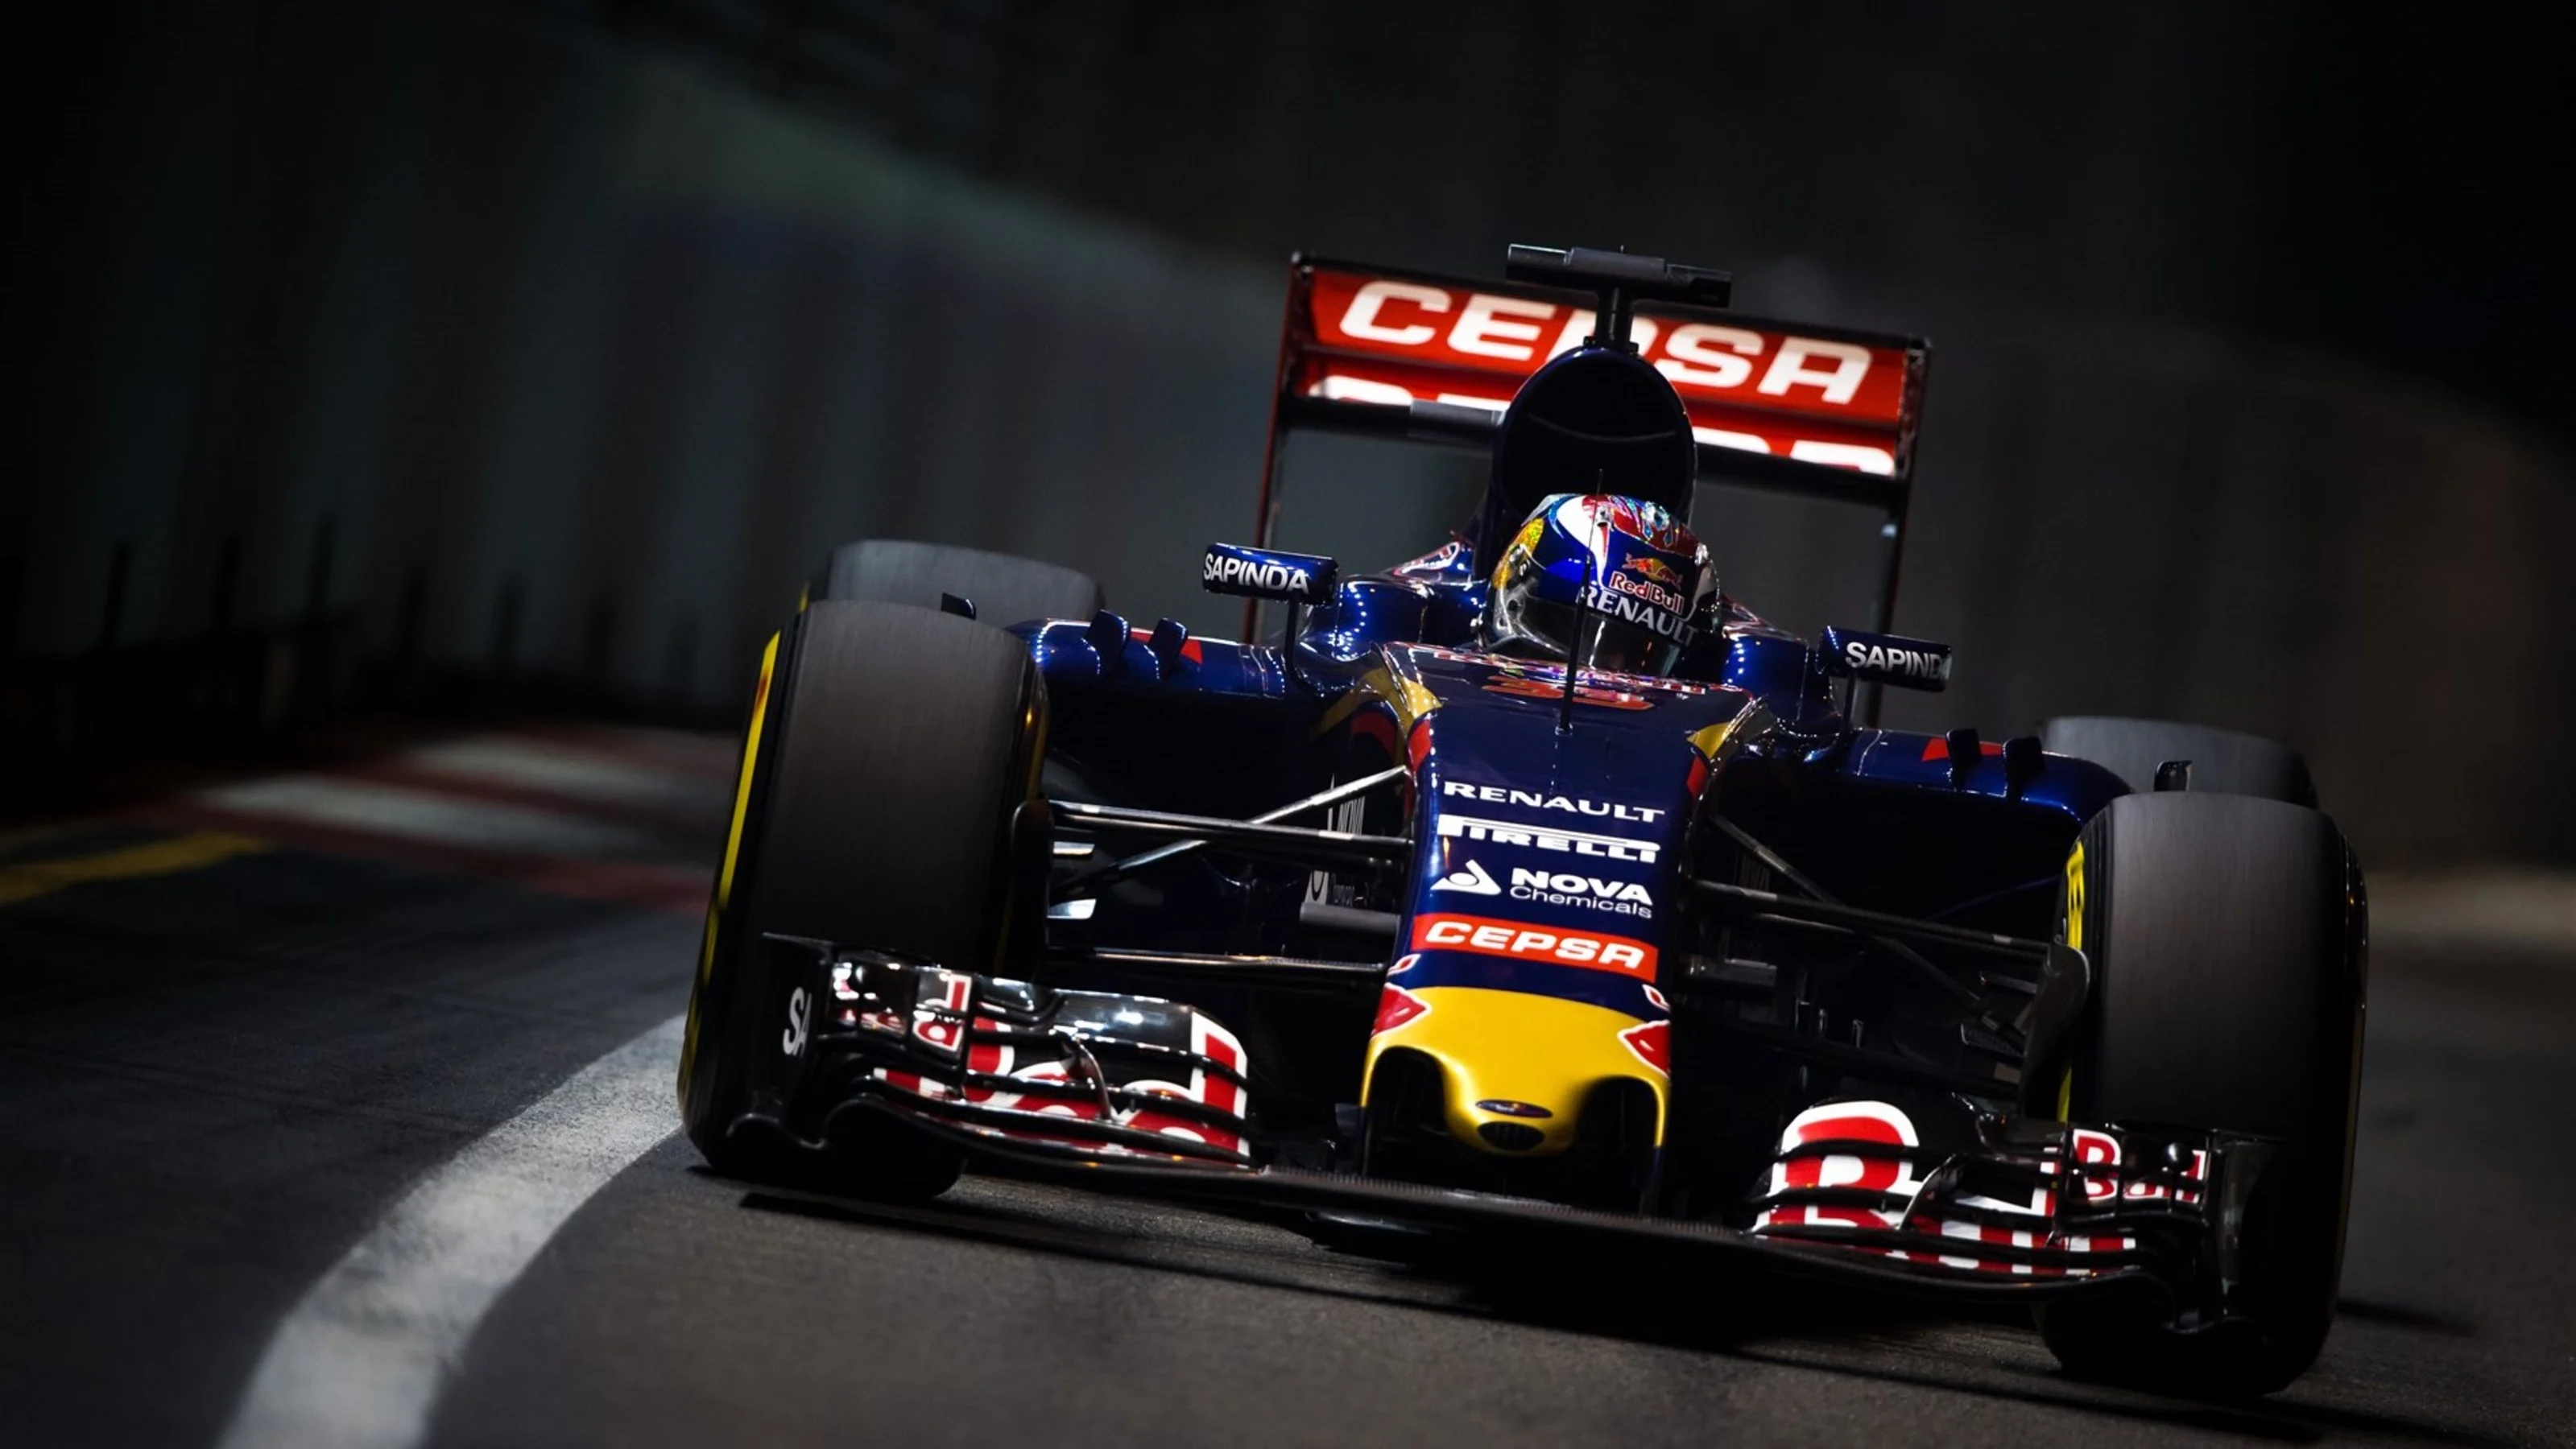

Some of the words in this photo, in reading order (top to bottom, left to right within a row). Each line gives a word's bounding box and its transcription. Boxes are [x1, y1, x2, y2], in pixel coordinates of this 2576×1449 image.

[1203, 552, 1310, 594] SAPINDA
[1611, 570, 1649, 600] Red
[1649, 585, 1685, 616] Bull
[1575, 585, 1698, 646] RENAULT
[1444, 780, 1665, 823] RENAULT
[1437, 814, 1661, 864] PIRELLI
[1509, 885, 1652, 919] Chemicals
[1511, 867, 1653, 906] NOVA
[1424, 920, 1645, 969] CEPSA
